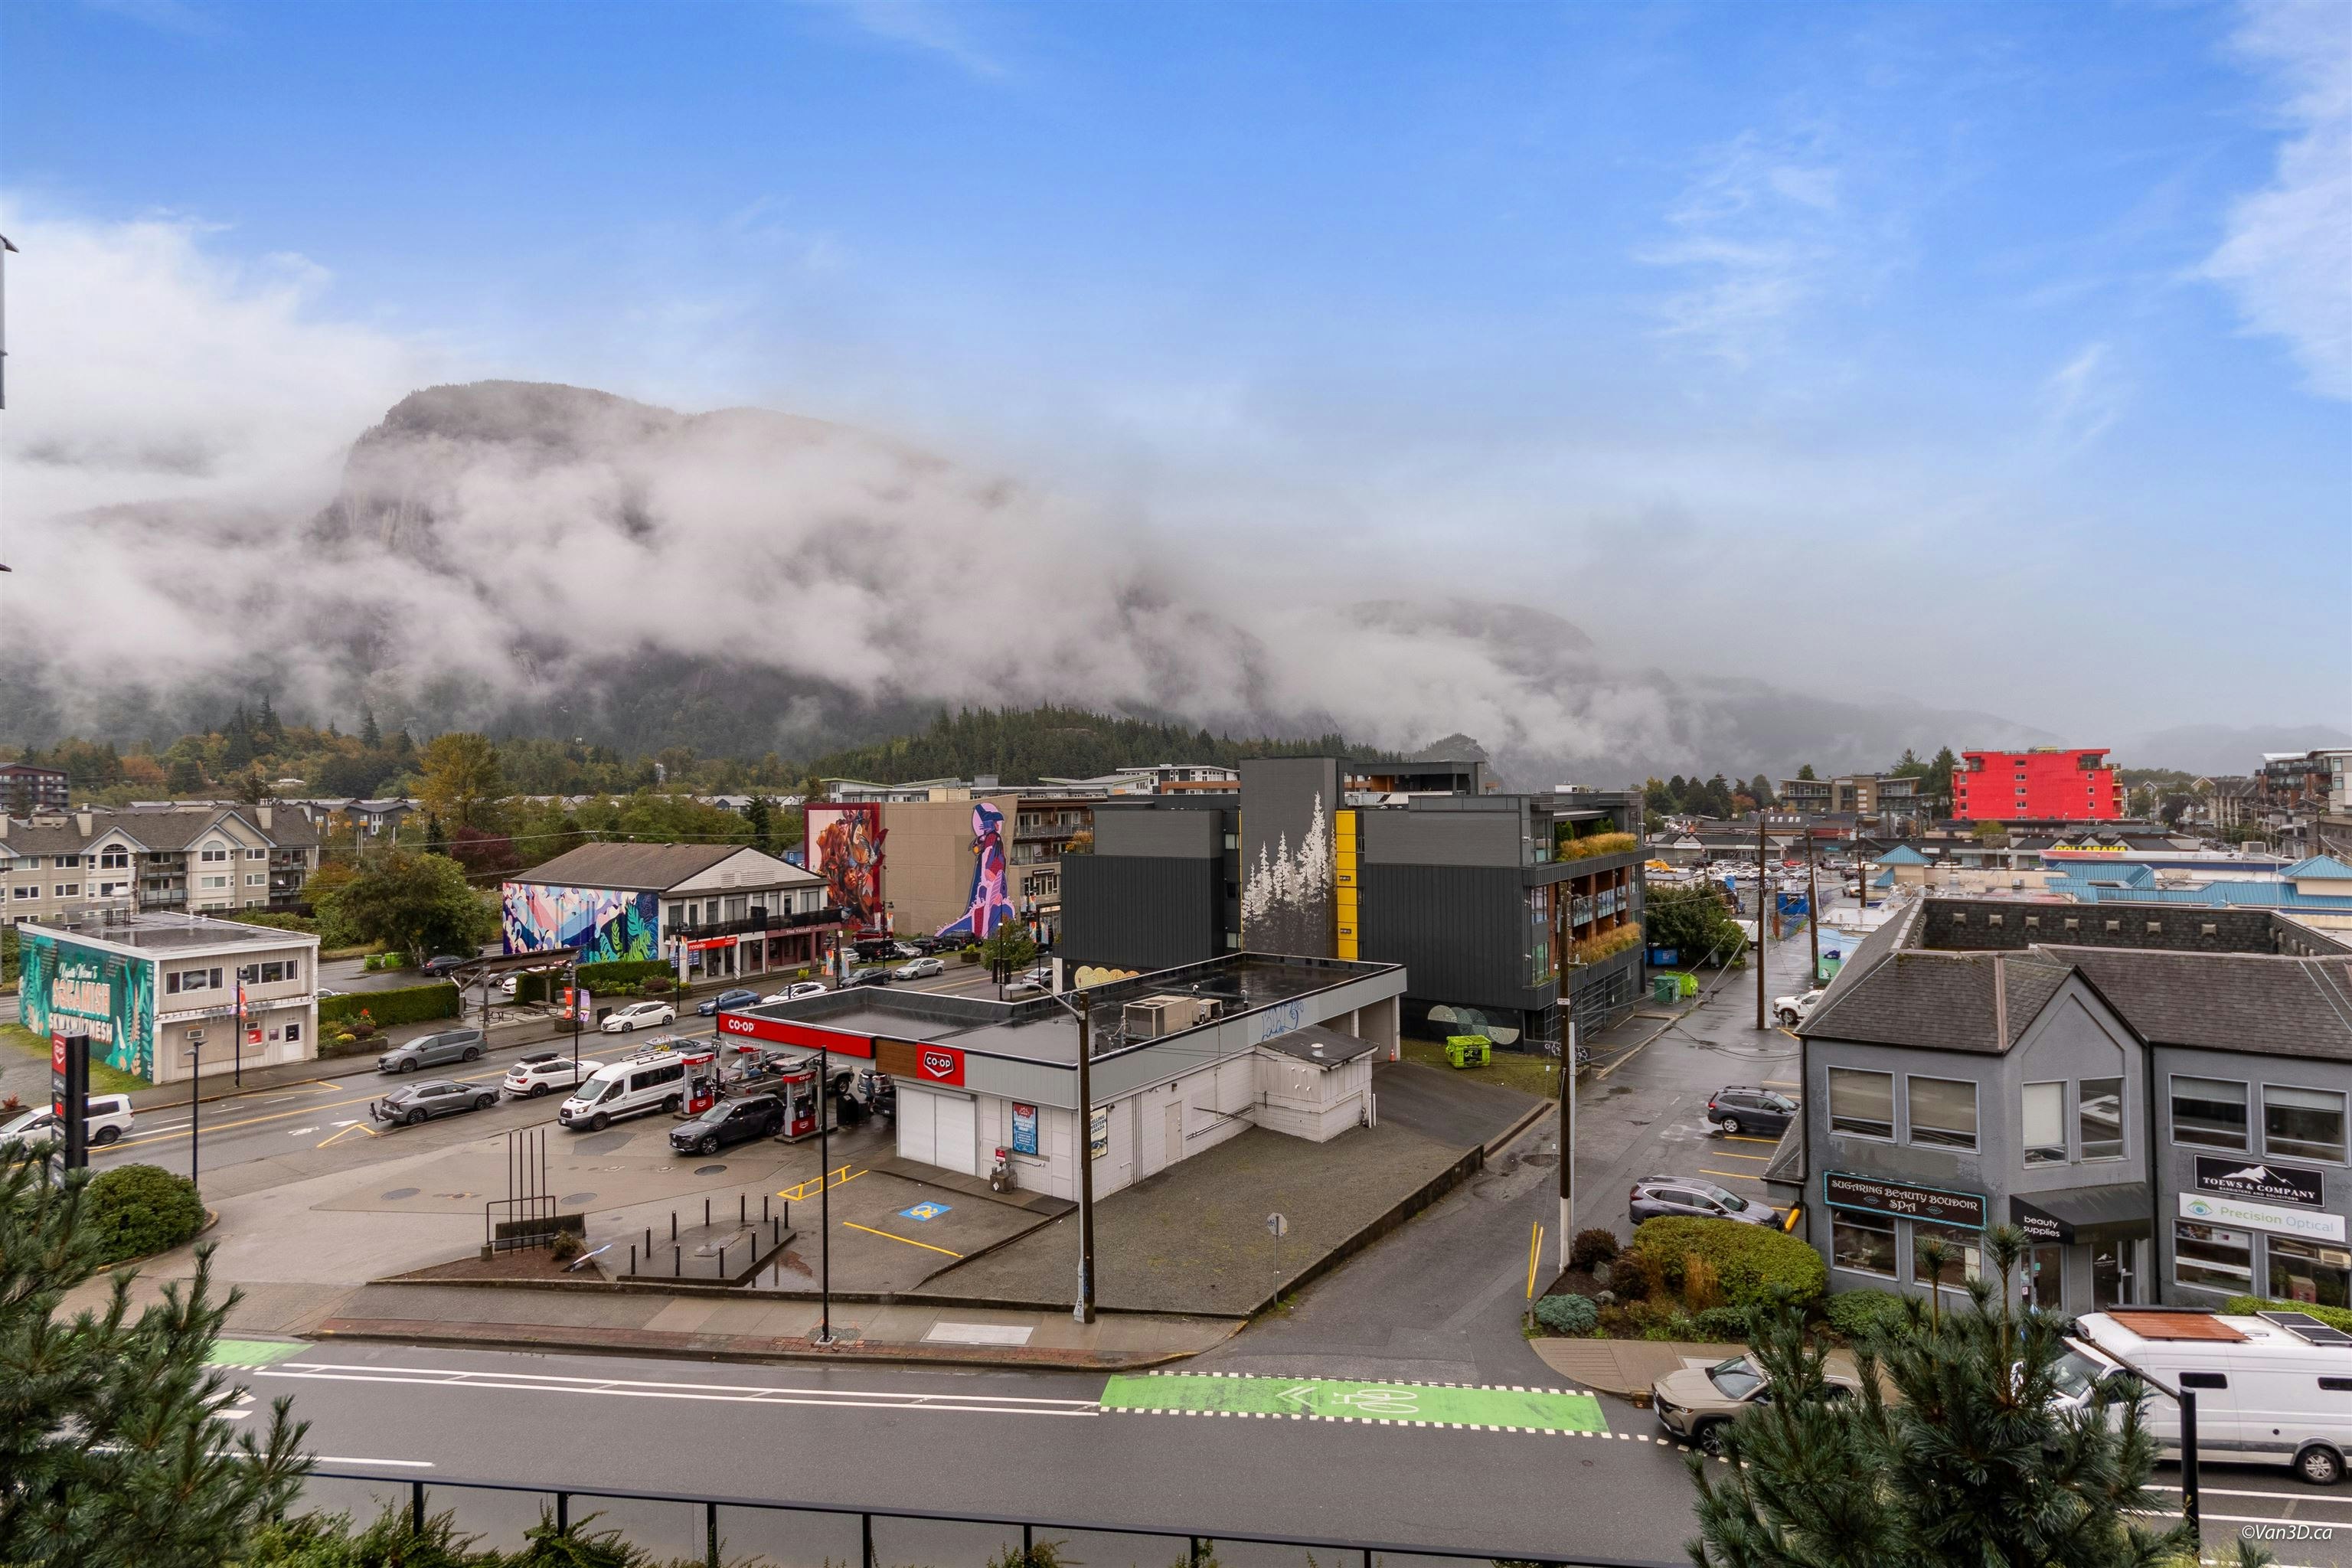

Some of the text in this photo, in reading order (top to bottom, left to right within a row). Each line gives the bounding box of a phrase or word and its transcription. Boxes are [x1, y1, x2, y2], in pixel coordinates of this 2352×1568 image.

[52, 978, 111, 1017] SQUAMISH
[728, 1019, 754, 1032] CO-OP
[926, 1056, 951, 1069] CO-OP
[1831, 1179, 1978, 1211] SUGARING BEAUTY BOUDOIR
[2203, 1177, 2243, 1189] TOEWS
[2258, 1184, 2316, 1199] COMPANY
[1889, 1198, 1916, 1213] SPA
[2024, 1215, 2059, 1229] beauty
[2220, 1206, 2334, 1232] Precision Optical
[2023, 1225, 2060, 1237] supplies
